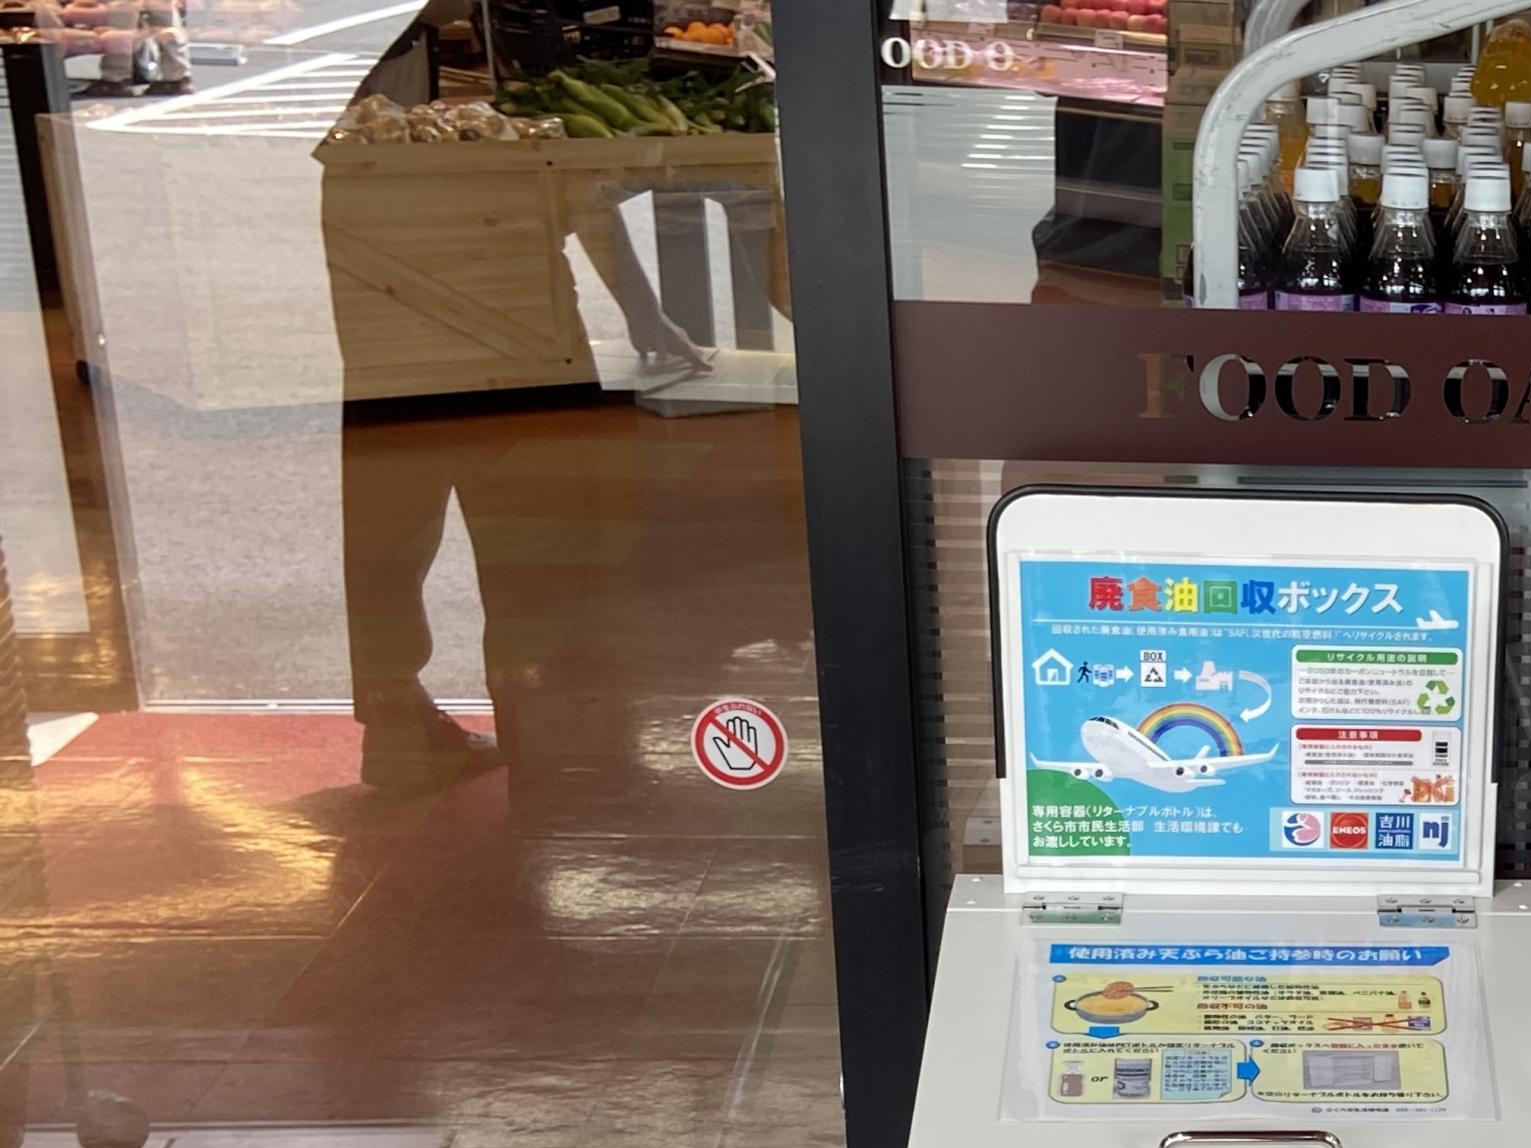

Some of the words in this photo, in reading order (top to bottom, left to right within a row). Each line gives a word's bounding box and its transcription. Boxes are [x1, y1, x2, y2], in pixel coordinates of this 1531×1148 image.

[1137, 353, 1411, 422] FOOD
[1088, 575, 1404, 616] 廃食油回収ボックス
[1143, 651, 1164, 662] BOX
[1379, 815, 1411, 829] 吉川
[1332, 826, 1367, 835] ENEOS
[1068, 946, 1423, 961] 使用済み天ぷら油ご持参時のお願い
